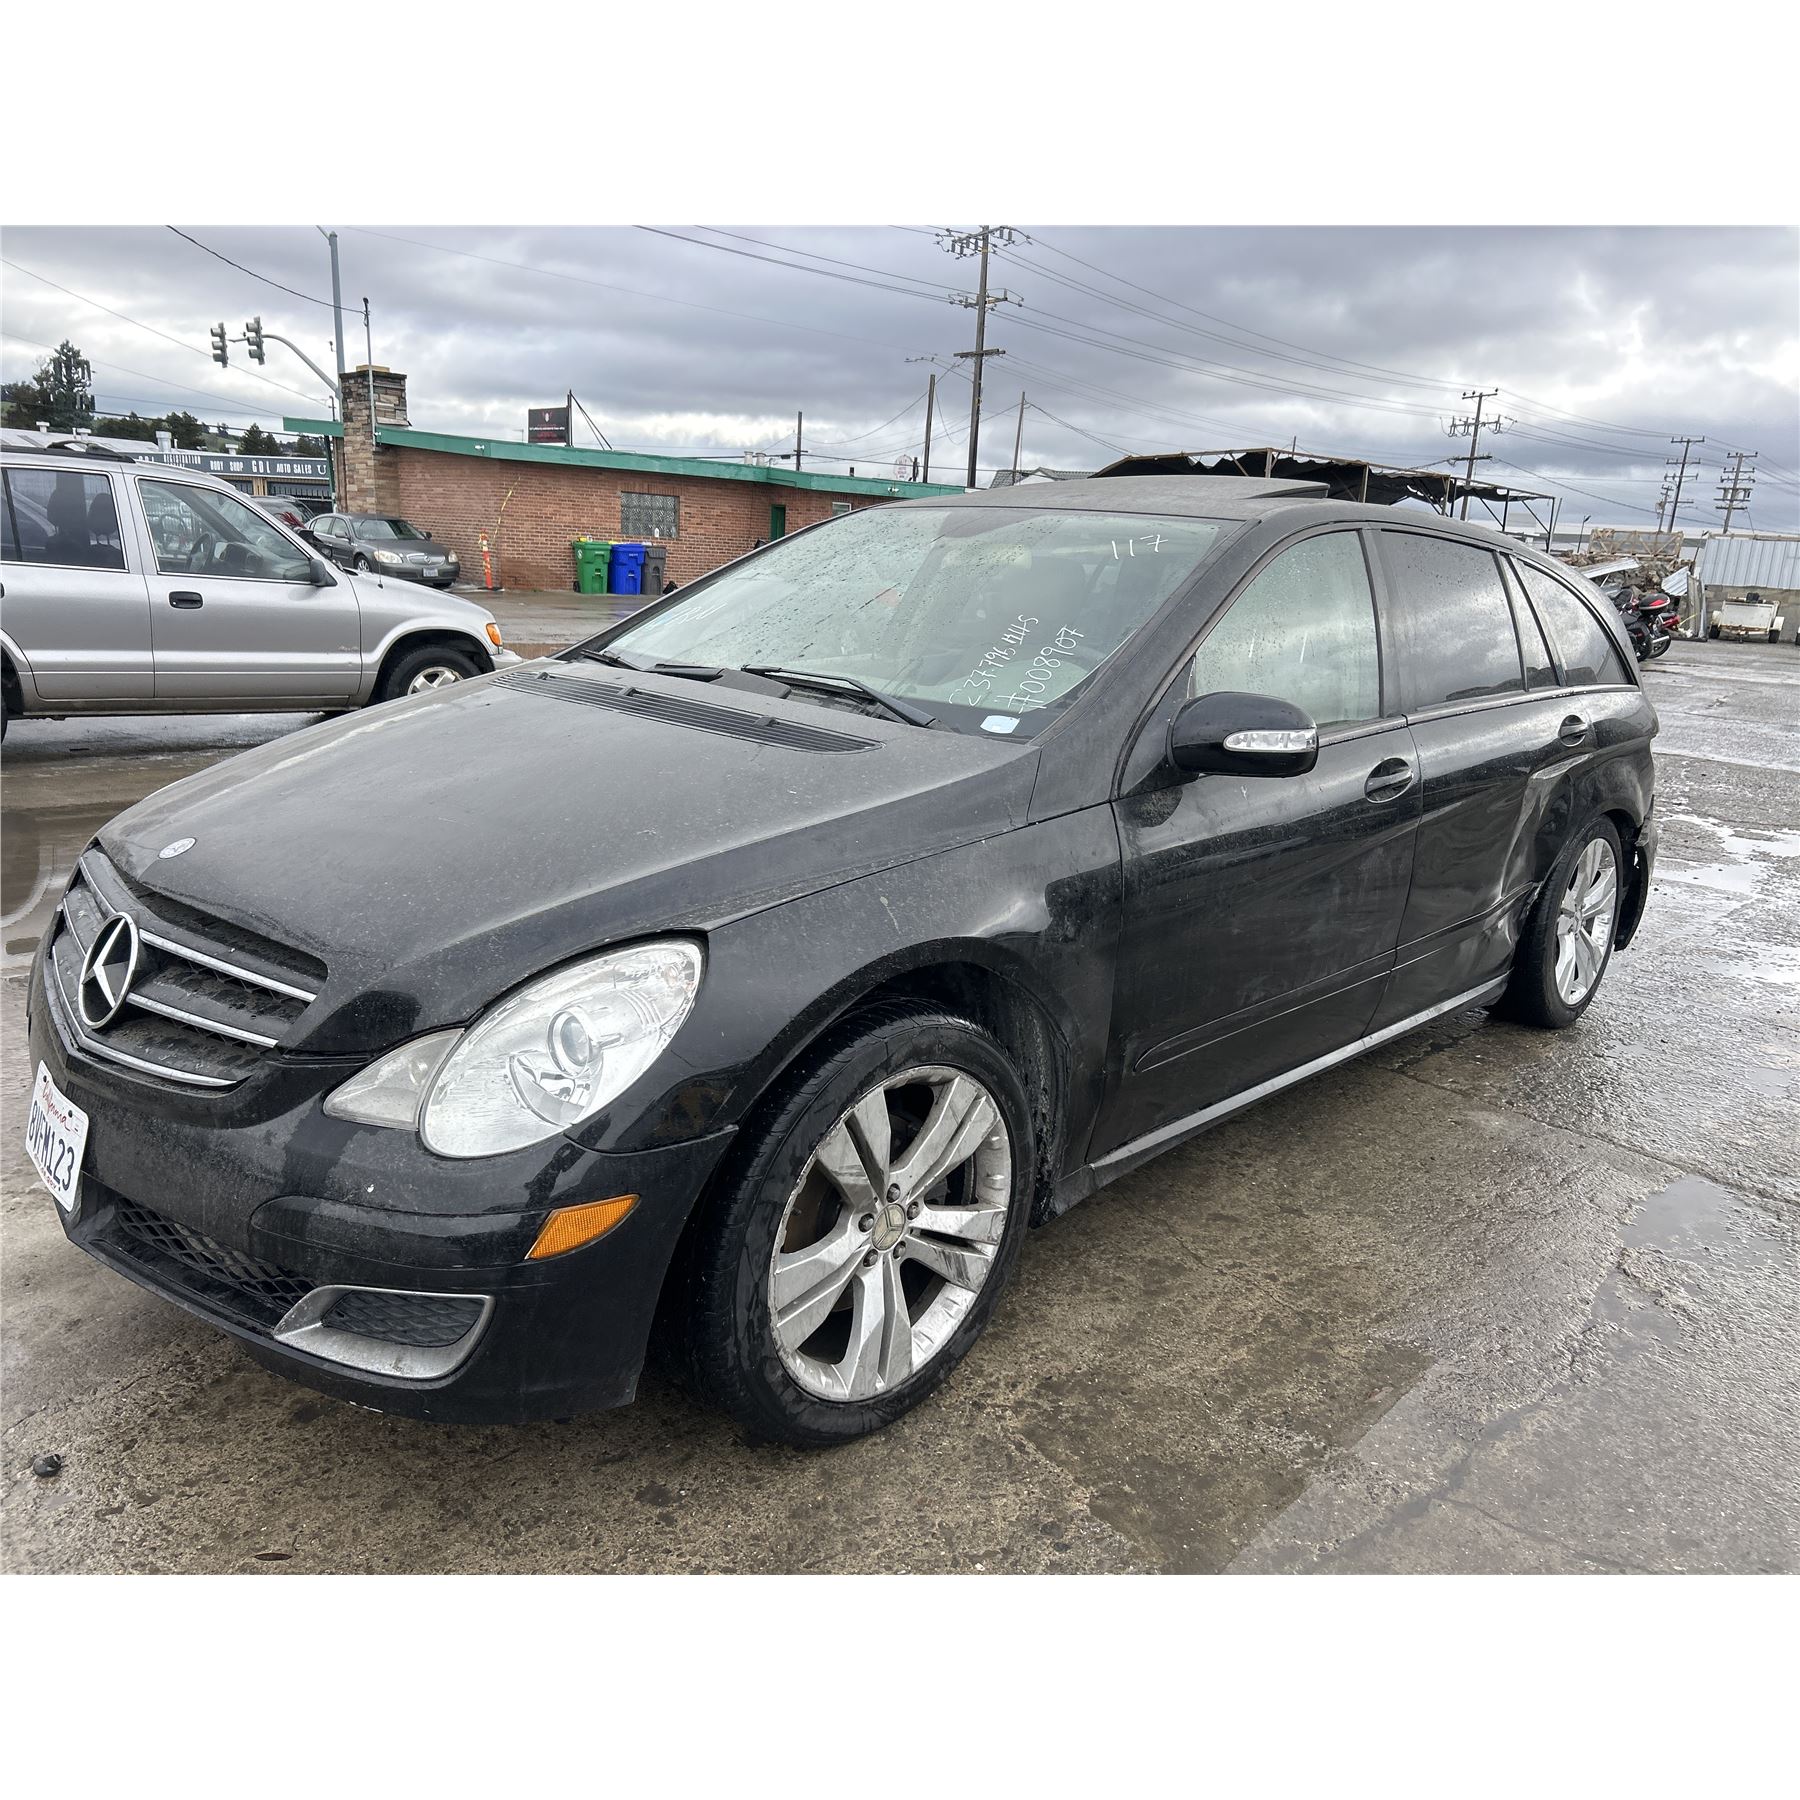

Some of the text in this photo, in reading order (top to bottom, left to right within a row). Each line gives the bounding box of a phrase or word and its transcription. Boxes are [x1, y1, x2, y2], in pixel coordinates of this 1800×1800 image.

[229, 461, 244, 472] SHOP
[276, 463, 292, 474] AUTO
[293, 463, 312, 474] SALES
[1111, 534, 1169, 560] 117
[996, 624, 1085, 715] #008907
